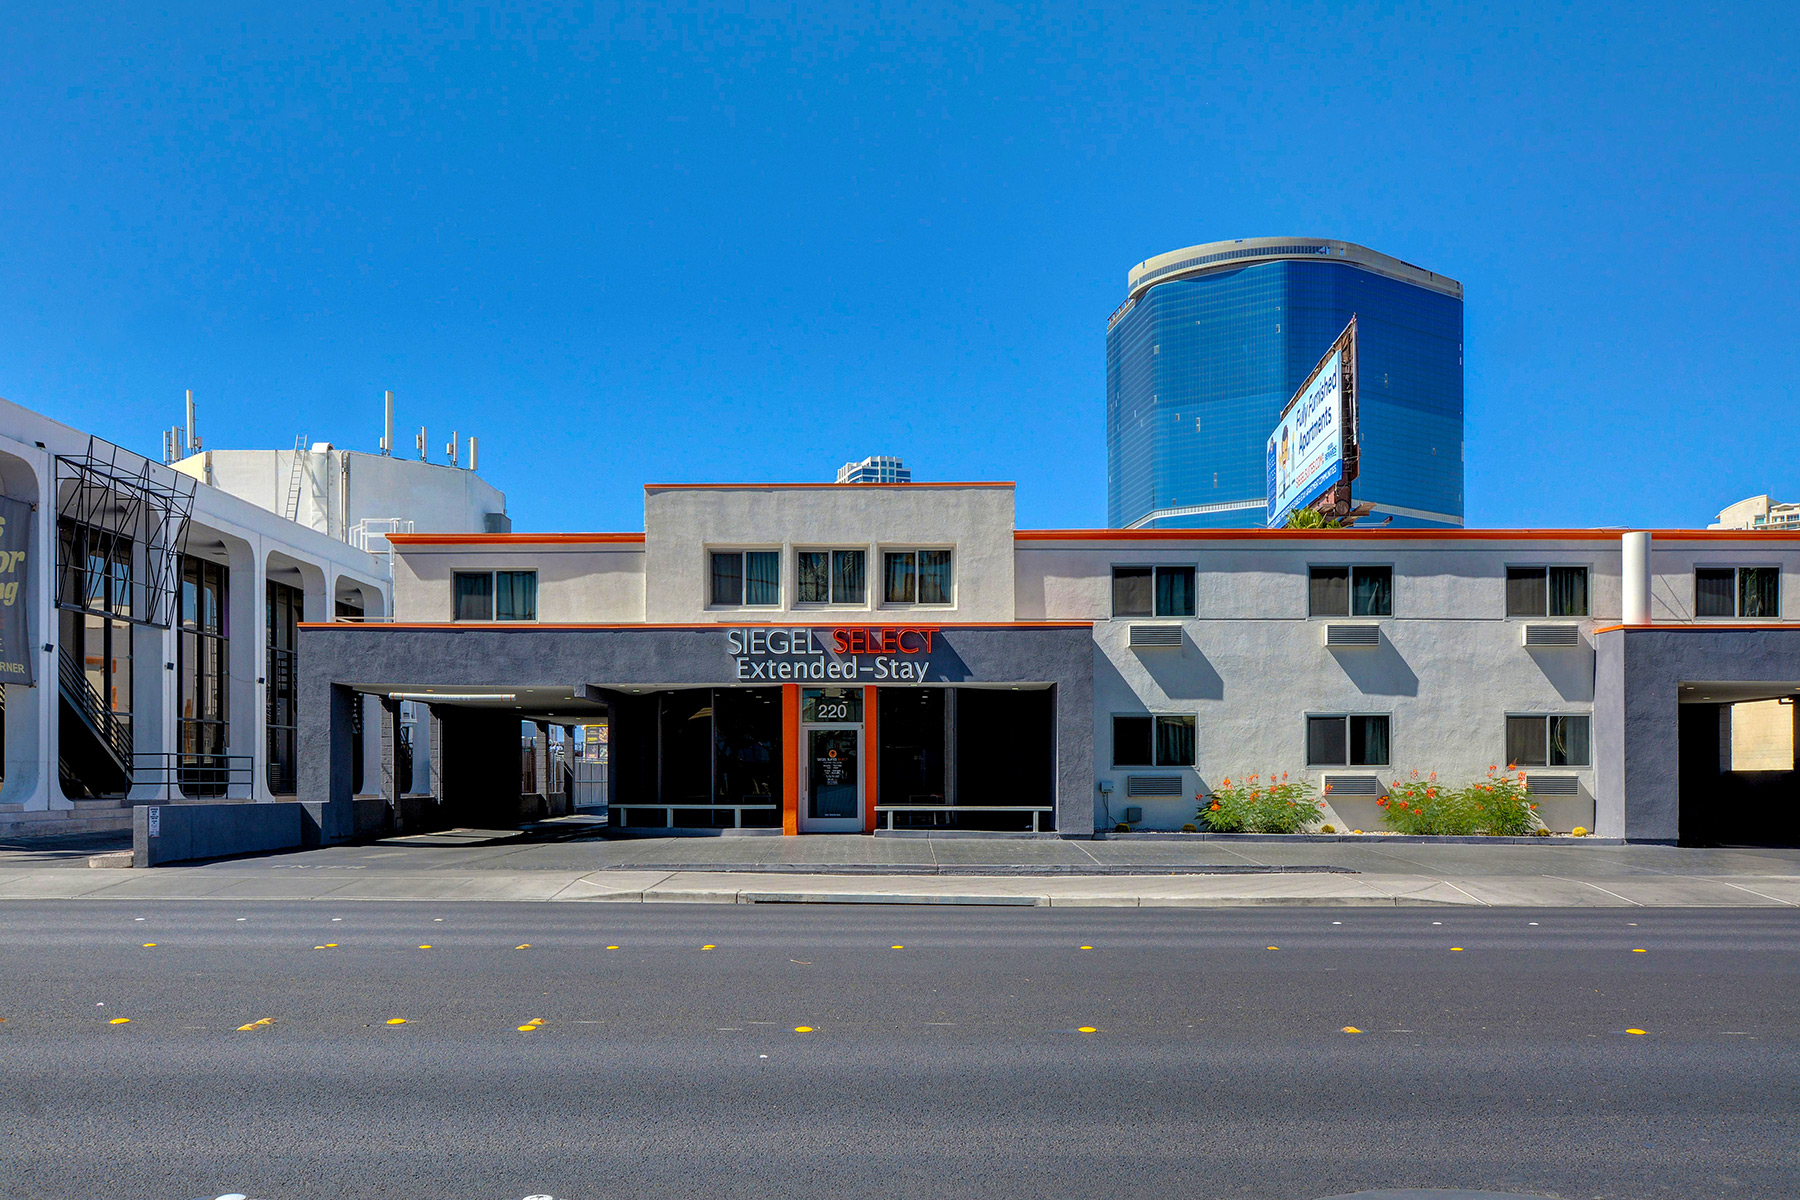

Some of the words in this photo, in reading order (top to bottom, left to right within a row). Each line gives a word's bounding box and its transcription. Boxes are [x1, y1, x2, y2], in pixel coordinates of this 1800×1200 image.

[1296, 402, 1309, 431] Fully
[1308, 364, 1337, 417] Furnished
[1299, 406, 1332, 457] Apartments
[727, 628, 823, 655] SIEGEL
[832, 628, 940, 654] SELECT
[736, 655, 930, 683] Extended-Stay
[818, 704, 847, 718] 220
